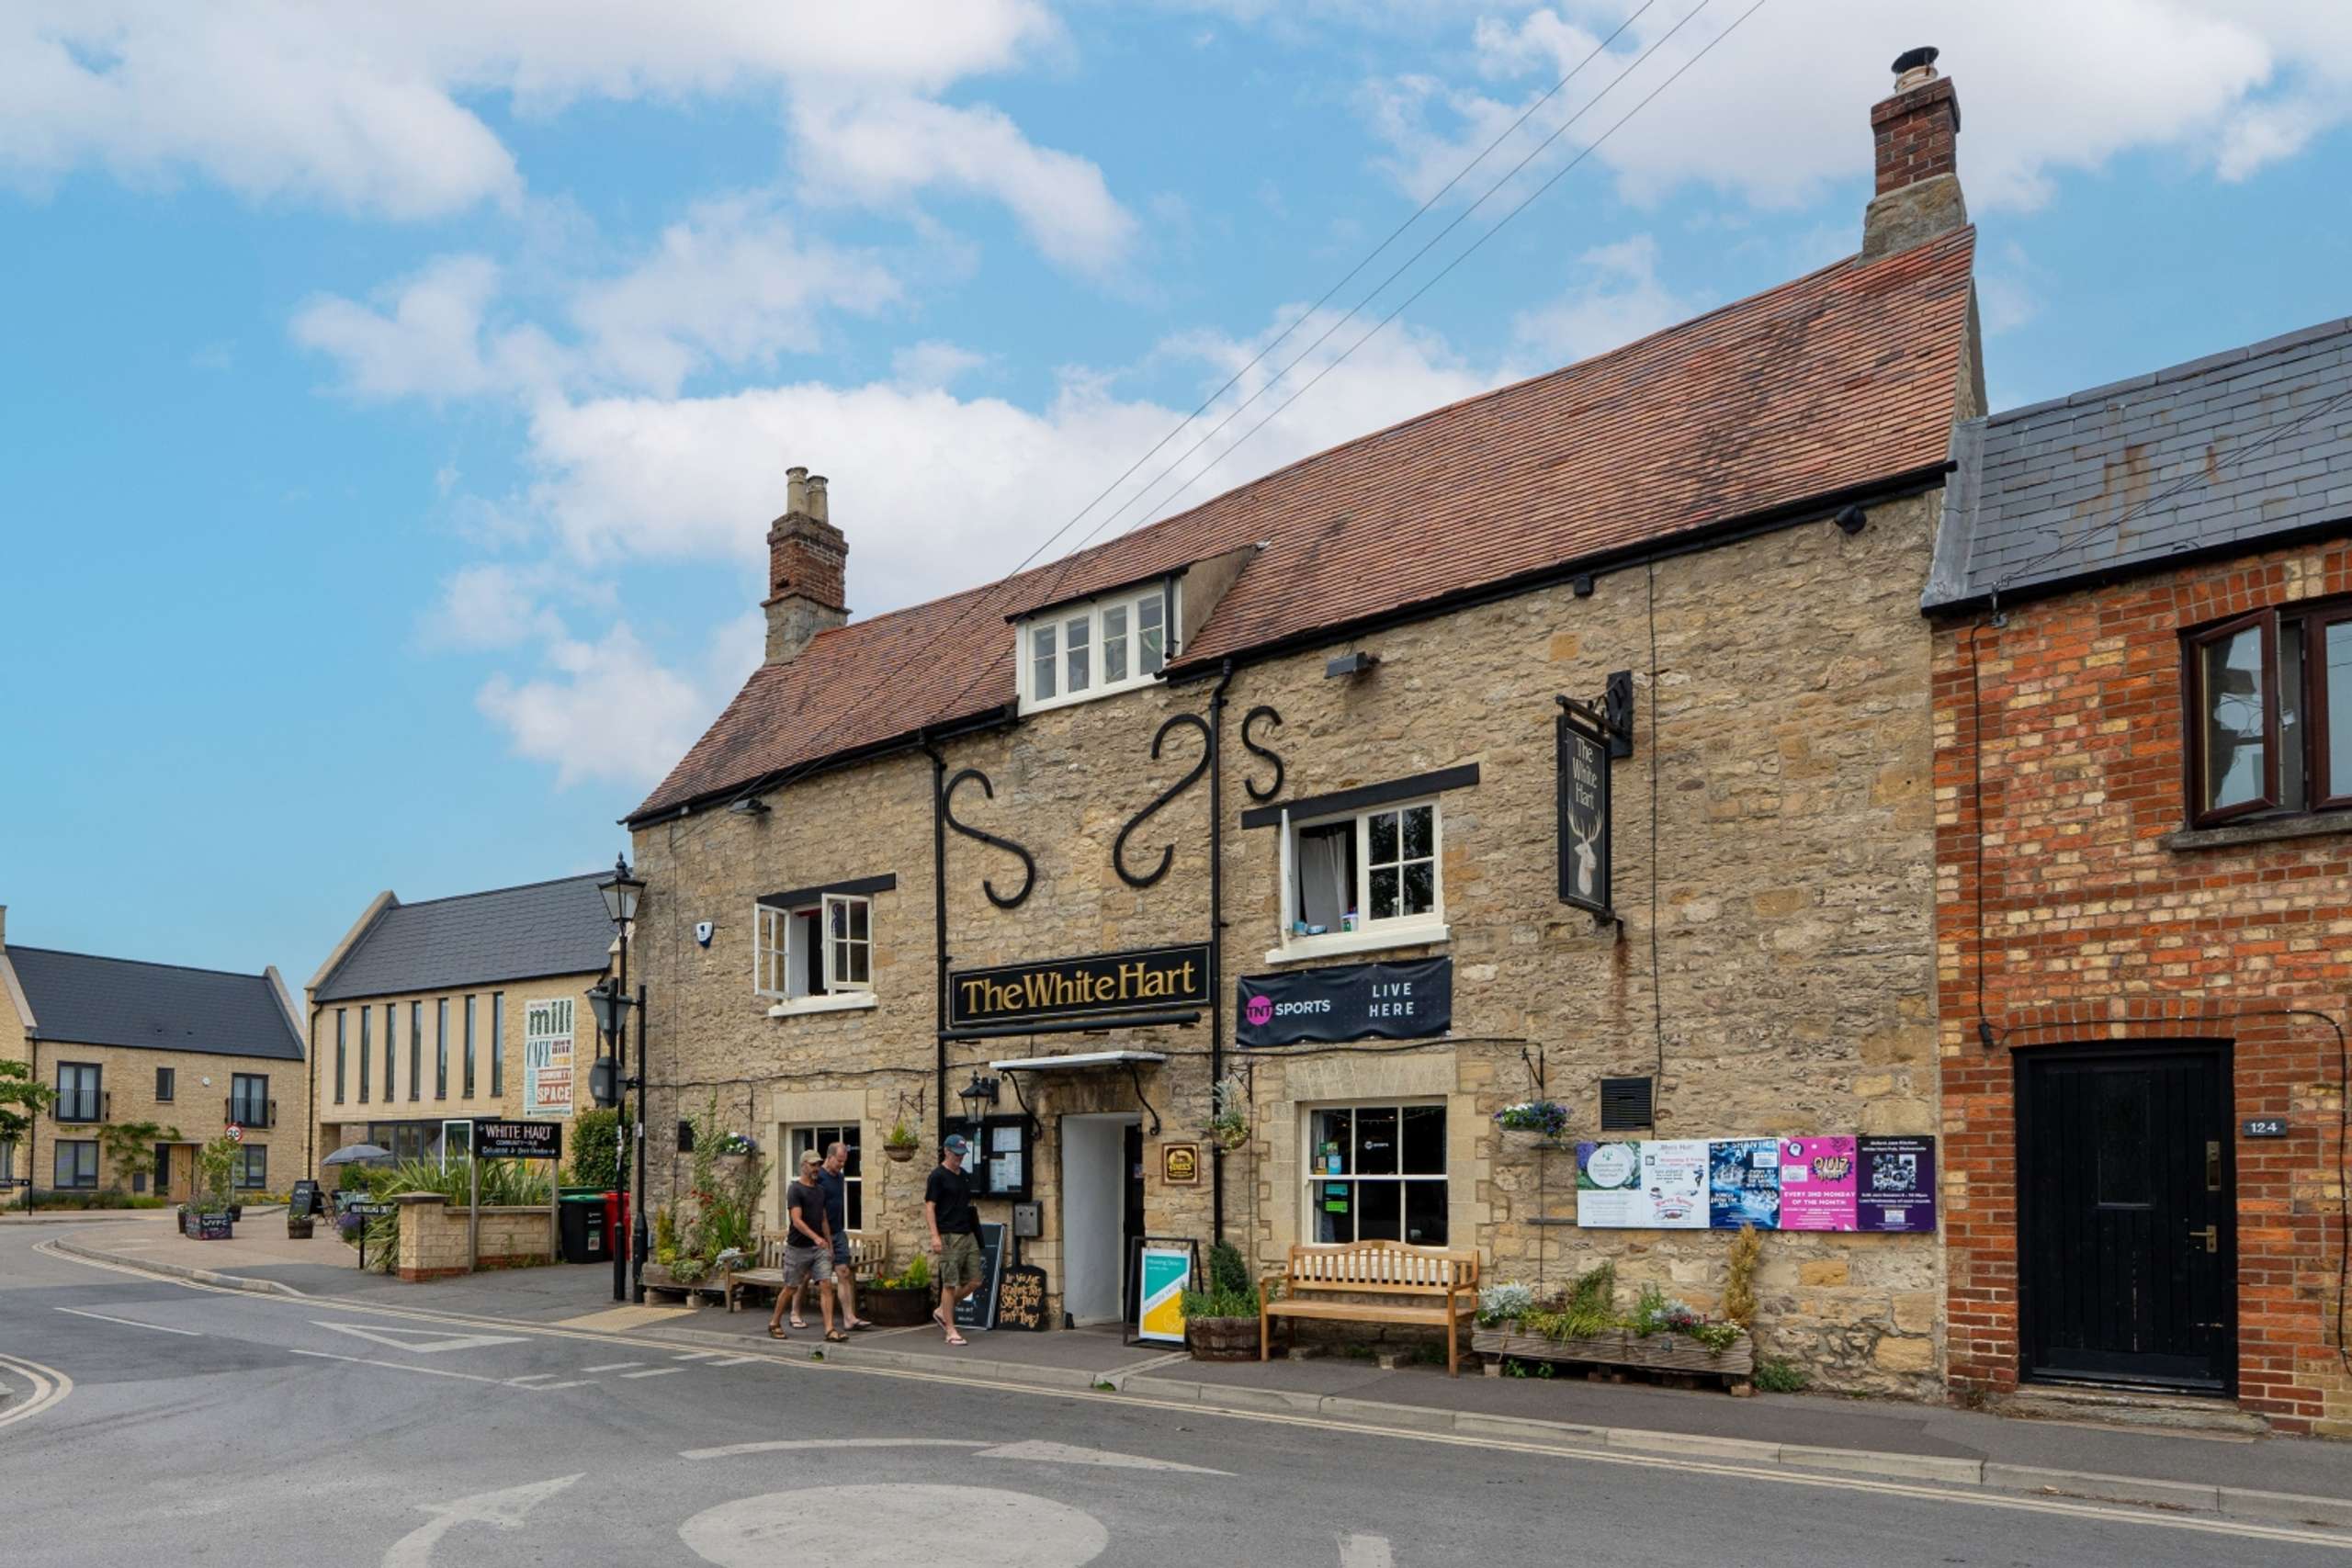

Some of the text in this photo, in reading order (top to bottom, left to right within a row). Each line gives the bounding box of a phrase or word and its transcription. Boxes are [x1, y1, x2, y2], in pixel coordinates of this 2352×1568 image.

[1575, 737, 1594, 763] The
[1572, 757, 1598, 789] White
[1575, 782, 1595, 810] Hart
[961, 960, 1197, 1014] The White Hart
[1372, 982, 1412, 998] LIVE
[529, 999, 572, 1035] mill
[1248, 999, 1330, 1018] TNT SPORTS
[1369, 1001, 1414, 1018] HERE
[537, 1086, 571, 1101] SPACE
[485, 1123, 521, 1139] WHITE
[523, 1125, 553, 1140] HART
[2251, 1122, 2278, 1134] 124
[1814, 1156, 1849, 1171] QUIZ
